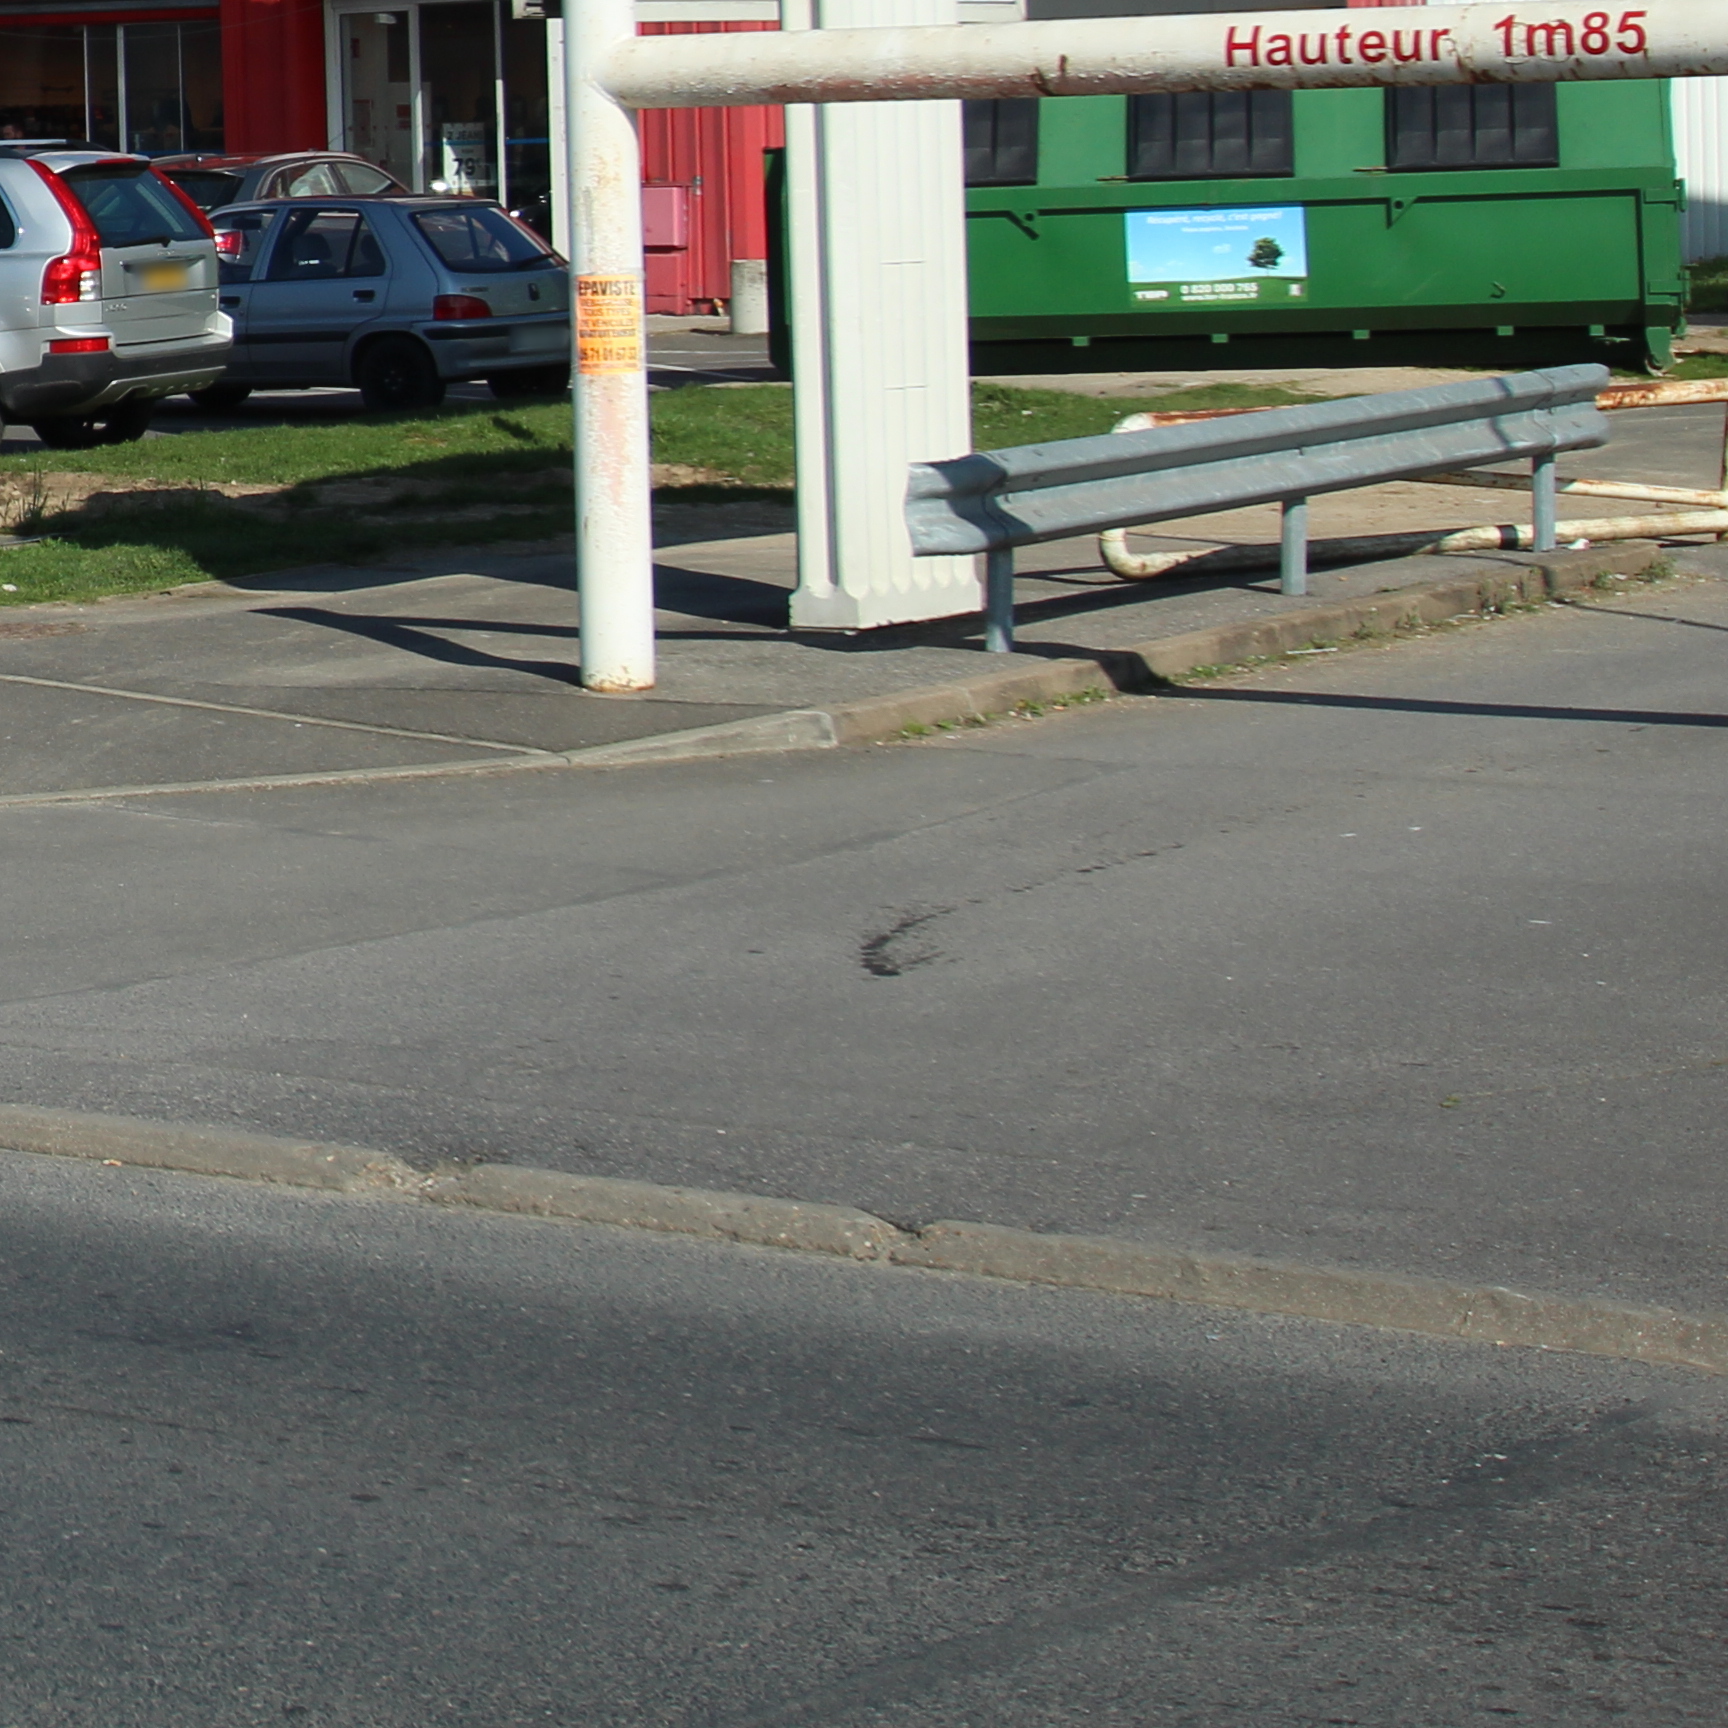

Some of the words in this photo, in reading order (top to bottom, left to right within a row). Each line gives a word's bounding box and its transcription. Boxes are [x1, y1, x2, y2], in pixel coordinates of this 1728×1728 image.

[1225, 24, 1450, 68] Hauteur
[1493, 10, 1648, 58] 1m85
[578, 280, 636, 297] EPAVISTE
